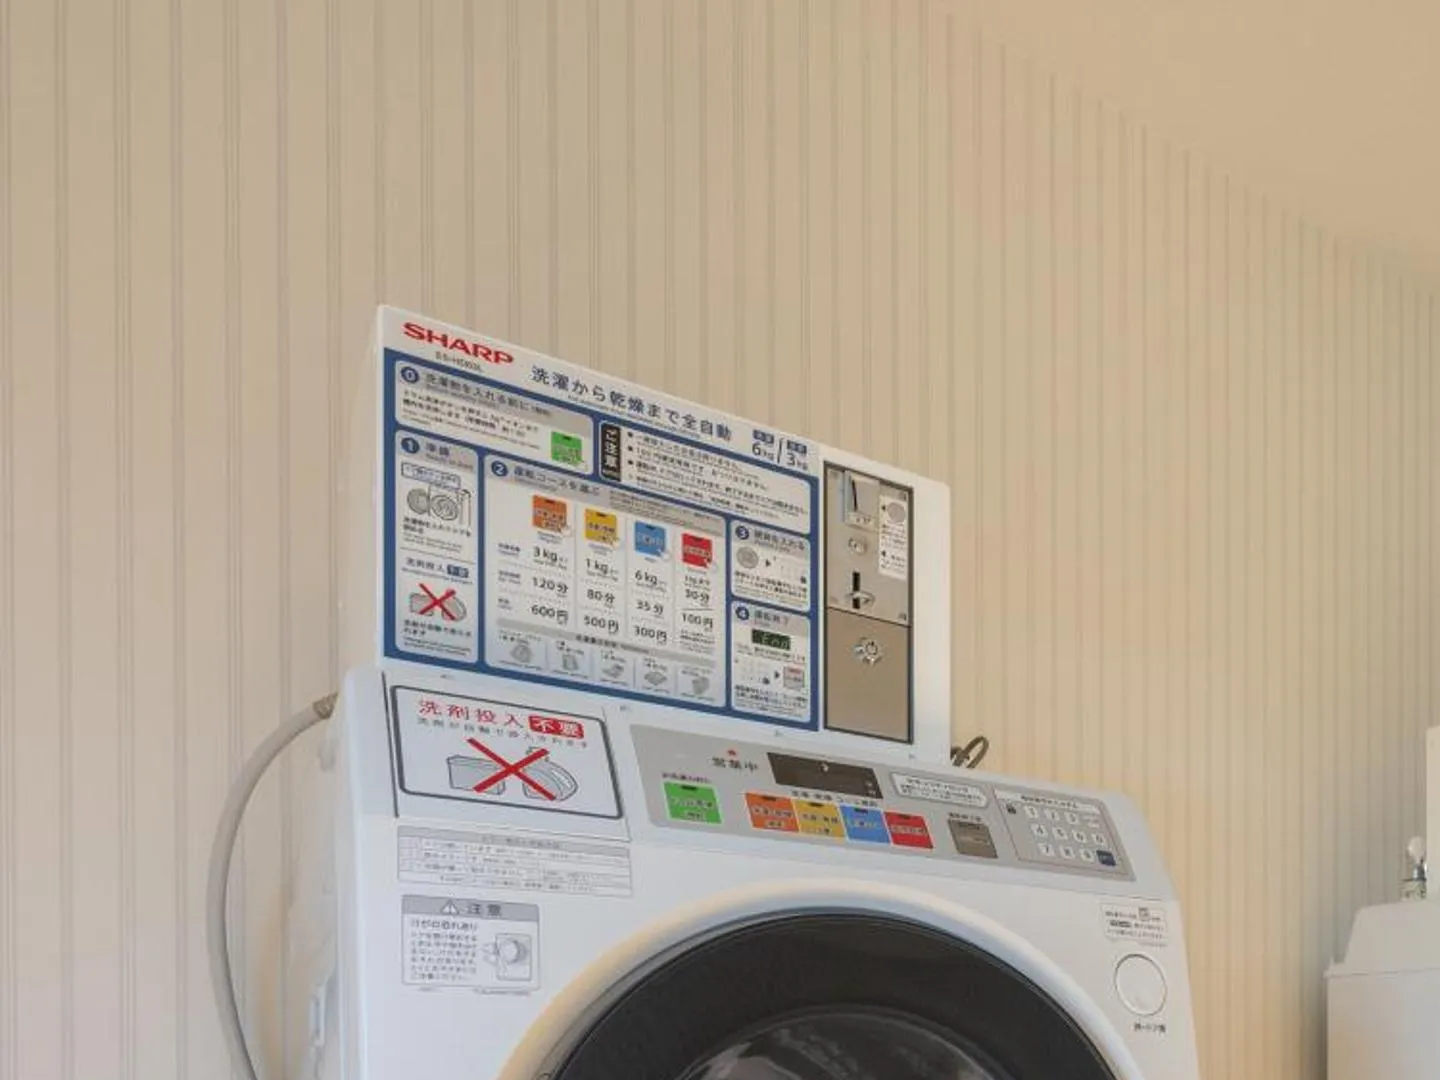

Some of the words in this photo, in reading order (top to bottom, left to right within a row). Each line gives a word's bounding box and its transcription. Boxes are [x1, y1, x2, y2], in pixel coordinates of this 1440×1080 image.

[403, 321, 514, 365] SHARP
[530, 364, 733, 442] 洗濯から乾燥まで全自動
[532, 577, 569, 594] 120分
[586, 589, 615, 604] 80分
[531, 604, 569, 622] 600円
[682, 613, 714, 629] 100円
[584, 615, 620, 633] 500円
[633, 625, 668, 642] 300円
